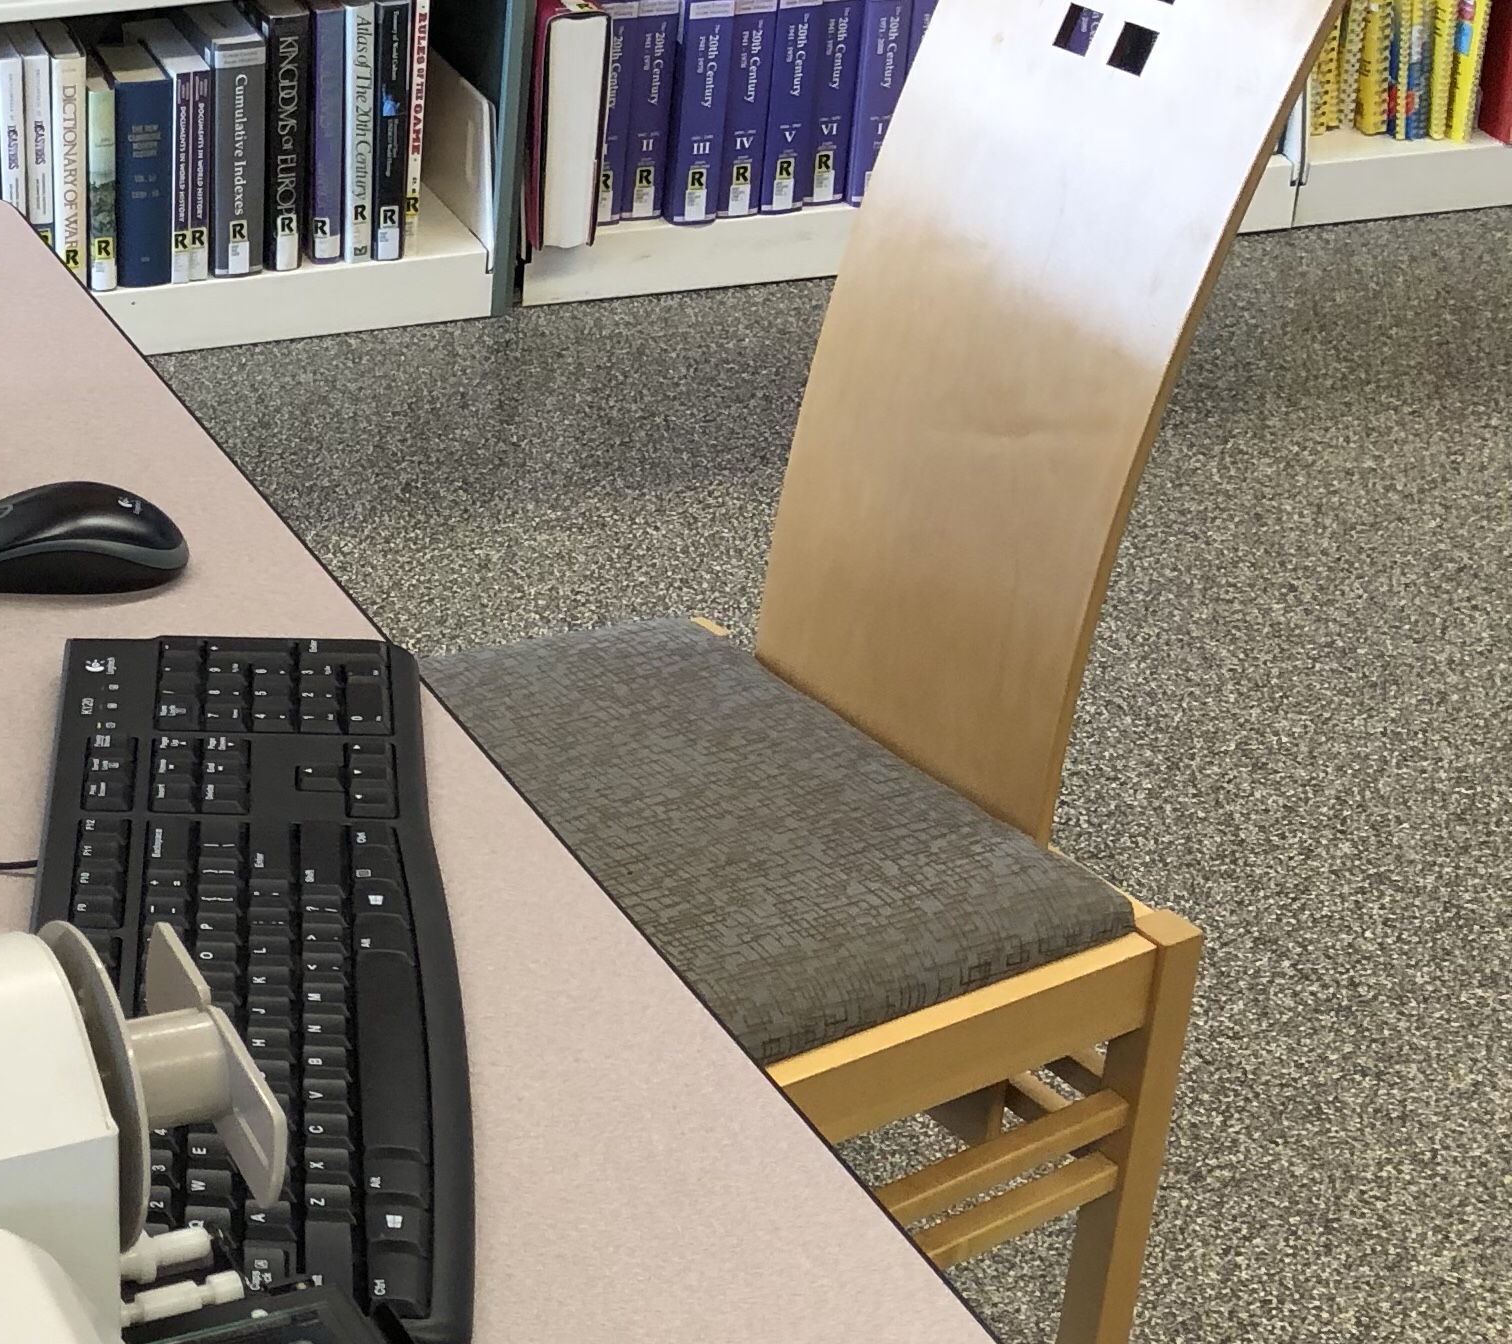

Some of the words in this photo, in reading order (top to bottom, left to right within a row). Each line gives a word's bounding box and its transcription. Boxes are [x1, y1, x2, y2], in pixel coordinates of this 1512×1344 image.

[357, 15, 372, 51] Atlas
[416, 13, 427, 64] RULES
[707, 36, 719, 59] 20th
[278, 36, 299, 135] KINGDOMS
[356, 69, 372, 103] The
[701, 62, 718, 108] Century
[235, 74, 247, 157] Cumulative
[356, 105, 371, 136] 20th
[412, 104, 423, 155] GAME
[63, 85, 77, 187] DICTIONARY
[693, 142, 710, 154] III
[235, 160, 247, 215] Indexes
[277, 155, 296, 215] EUROP
[353, 141, 371, 200] Century
[691, 171, 704, 187] R
[64, 187, 78, 212] OF
[232, 223, 245, 239] R
[252, 1039, 266, 1047] H
[309, 1125, 324, 1133] C
[191, 1180, 206, 1191] W
[310, 1198, 325, 1206] Z
